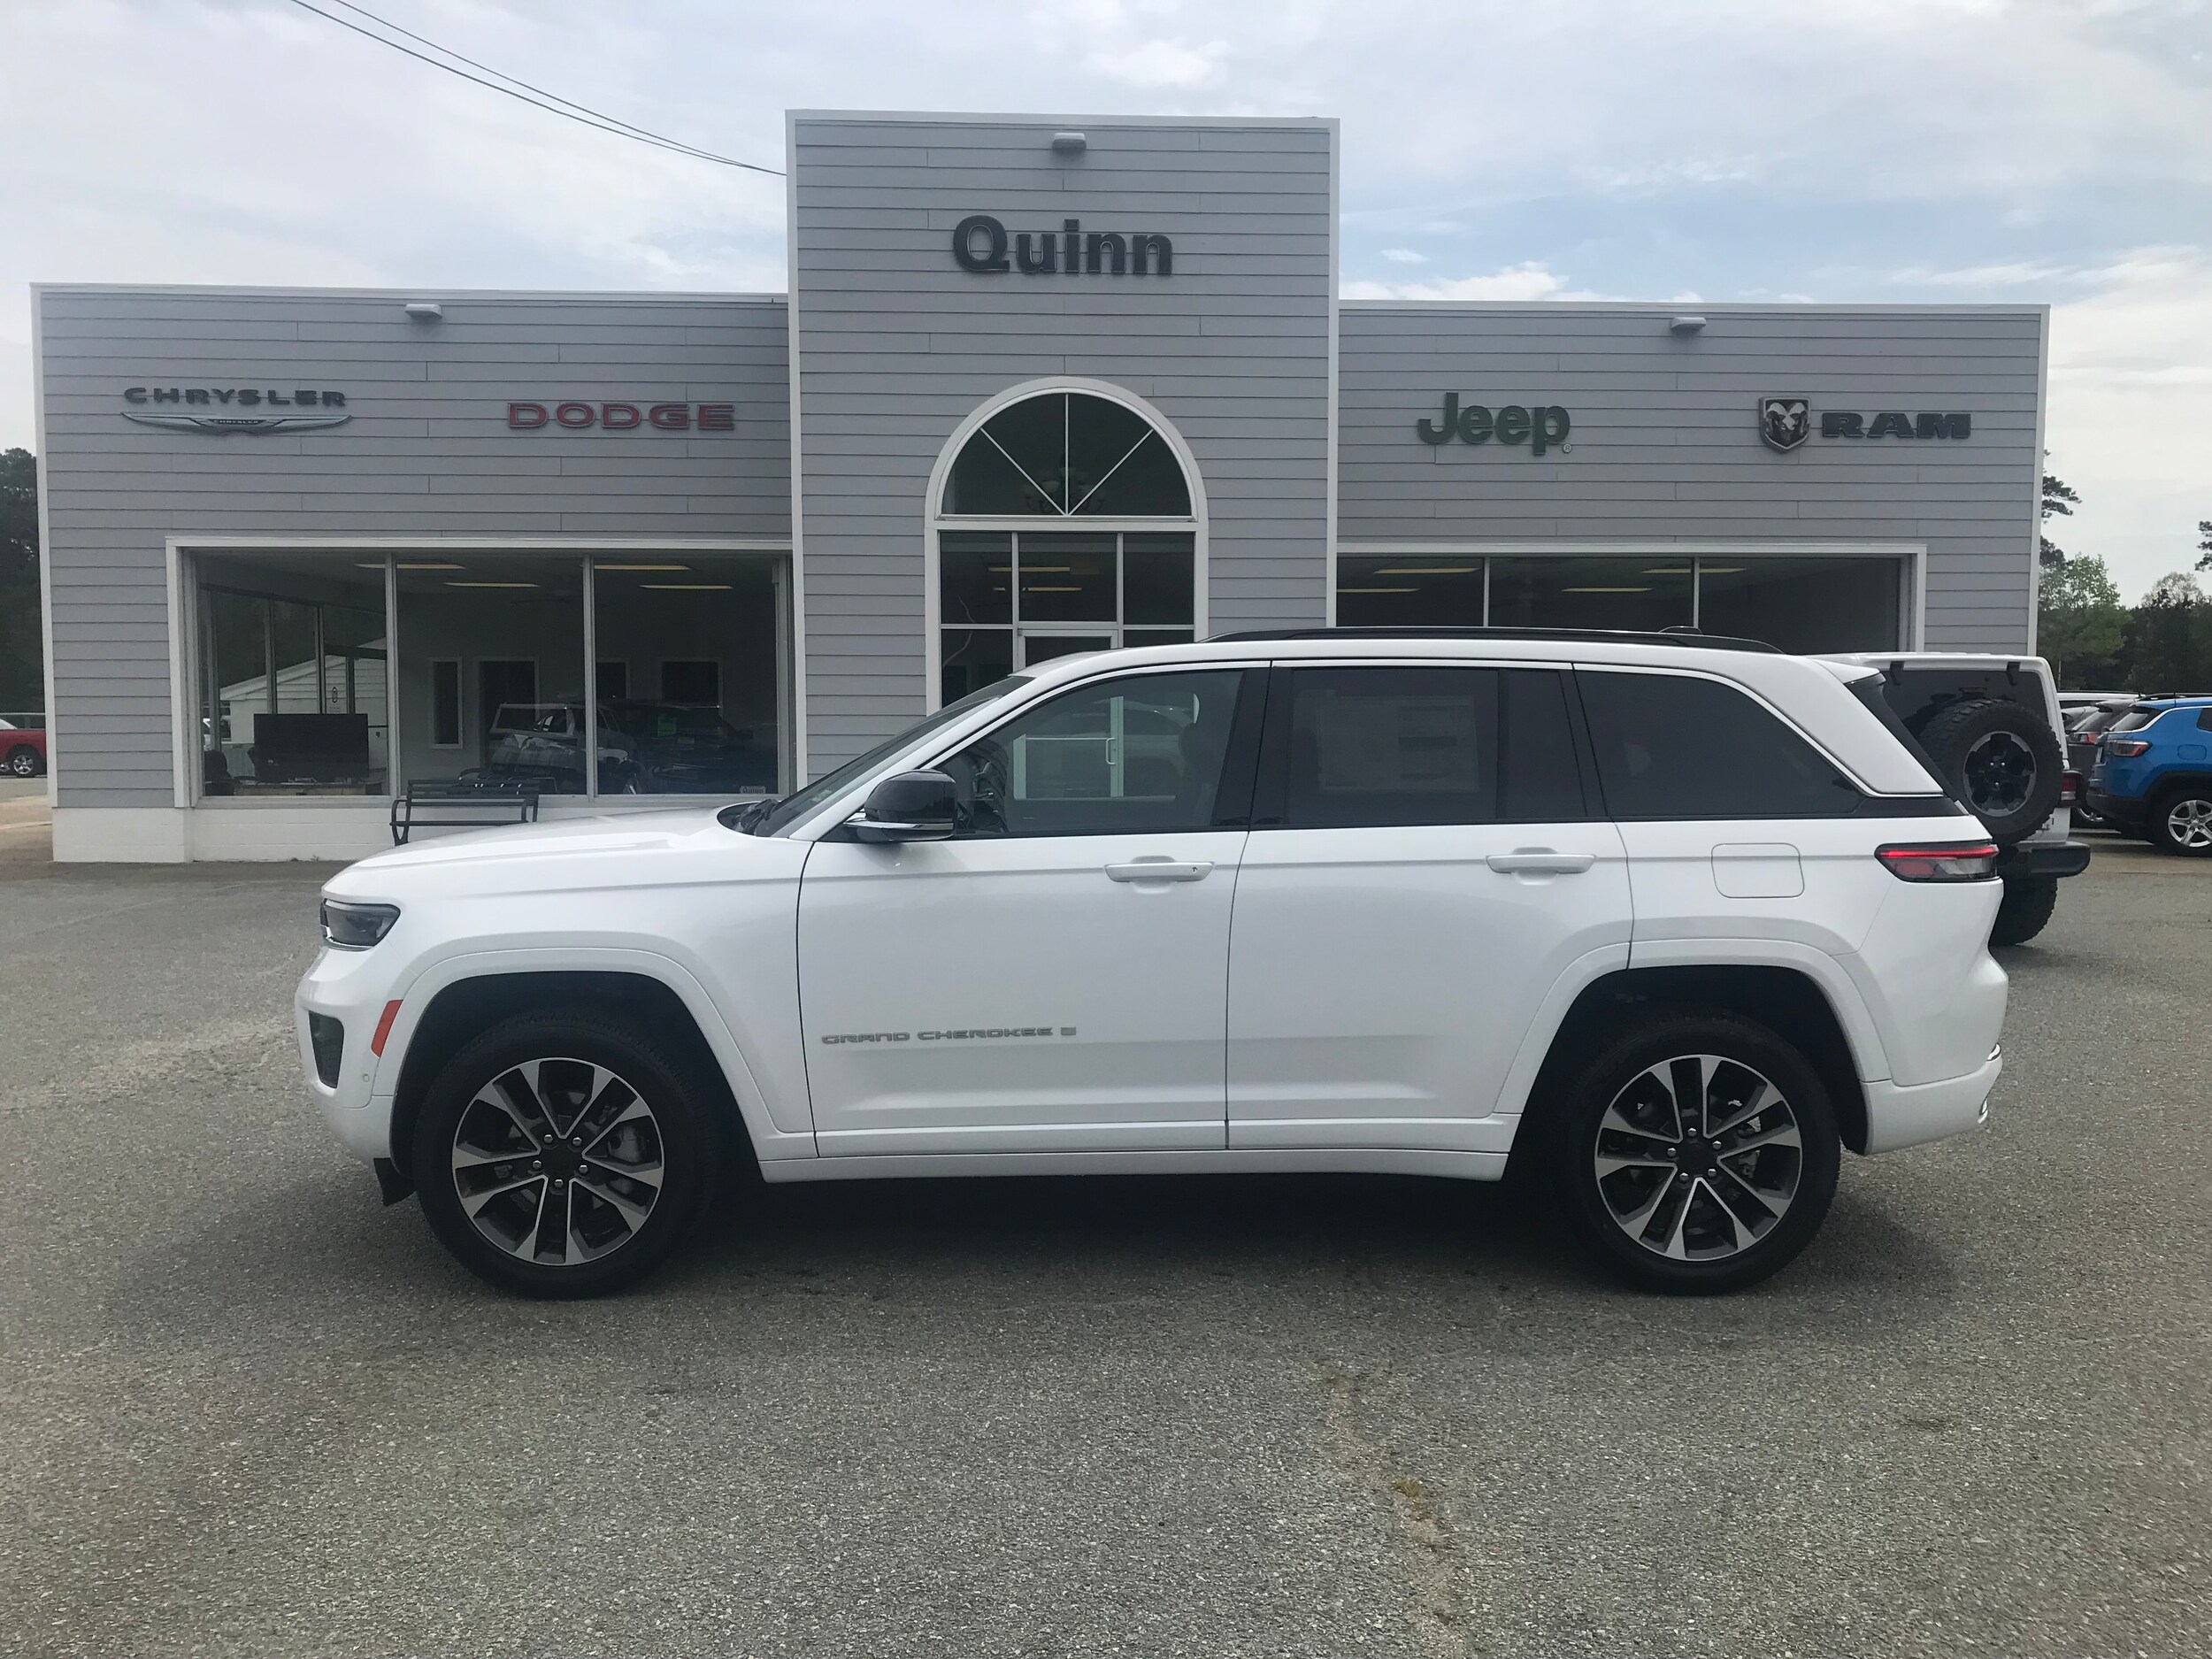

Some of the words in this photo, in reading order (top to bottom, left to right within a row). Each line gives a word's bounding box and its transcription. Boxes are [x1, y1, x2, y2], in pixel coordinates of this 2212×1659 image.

[953, 215, 1172, 274] Quinn
[123, 388, 346, 406] CHRYSLER
[508, 403, 734, 430] DODGE
[1417, 392, 1571, 456] Jeep
[1822, 412, 1972, 439] RAM
[821, 1032, 910, 1044] GRAND
[917, 1026, 1054, 1041] CHEROKEE
